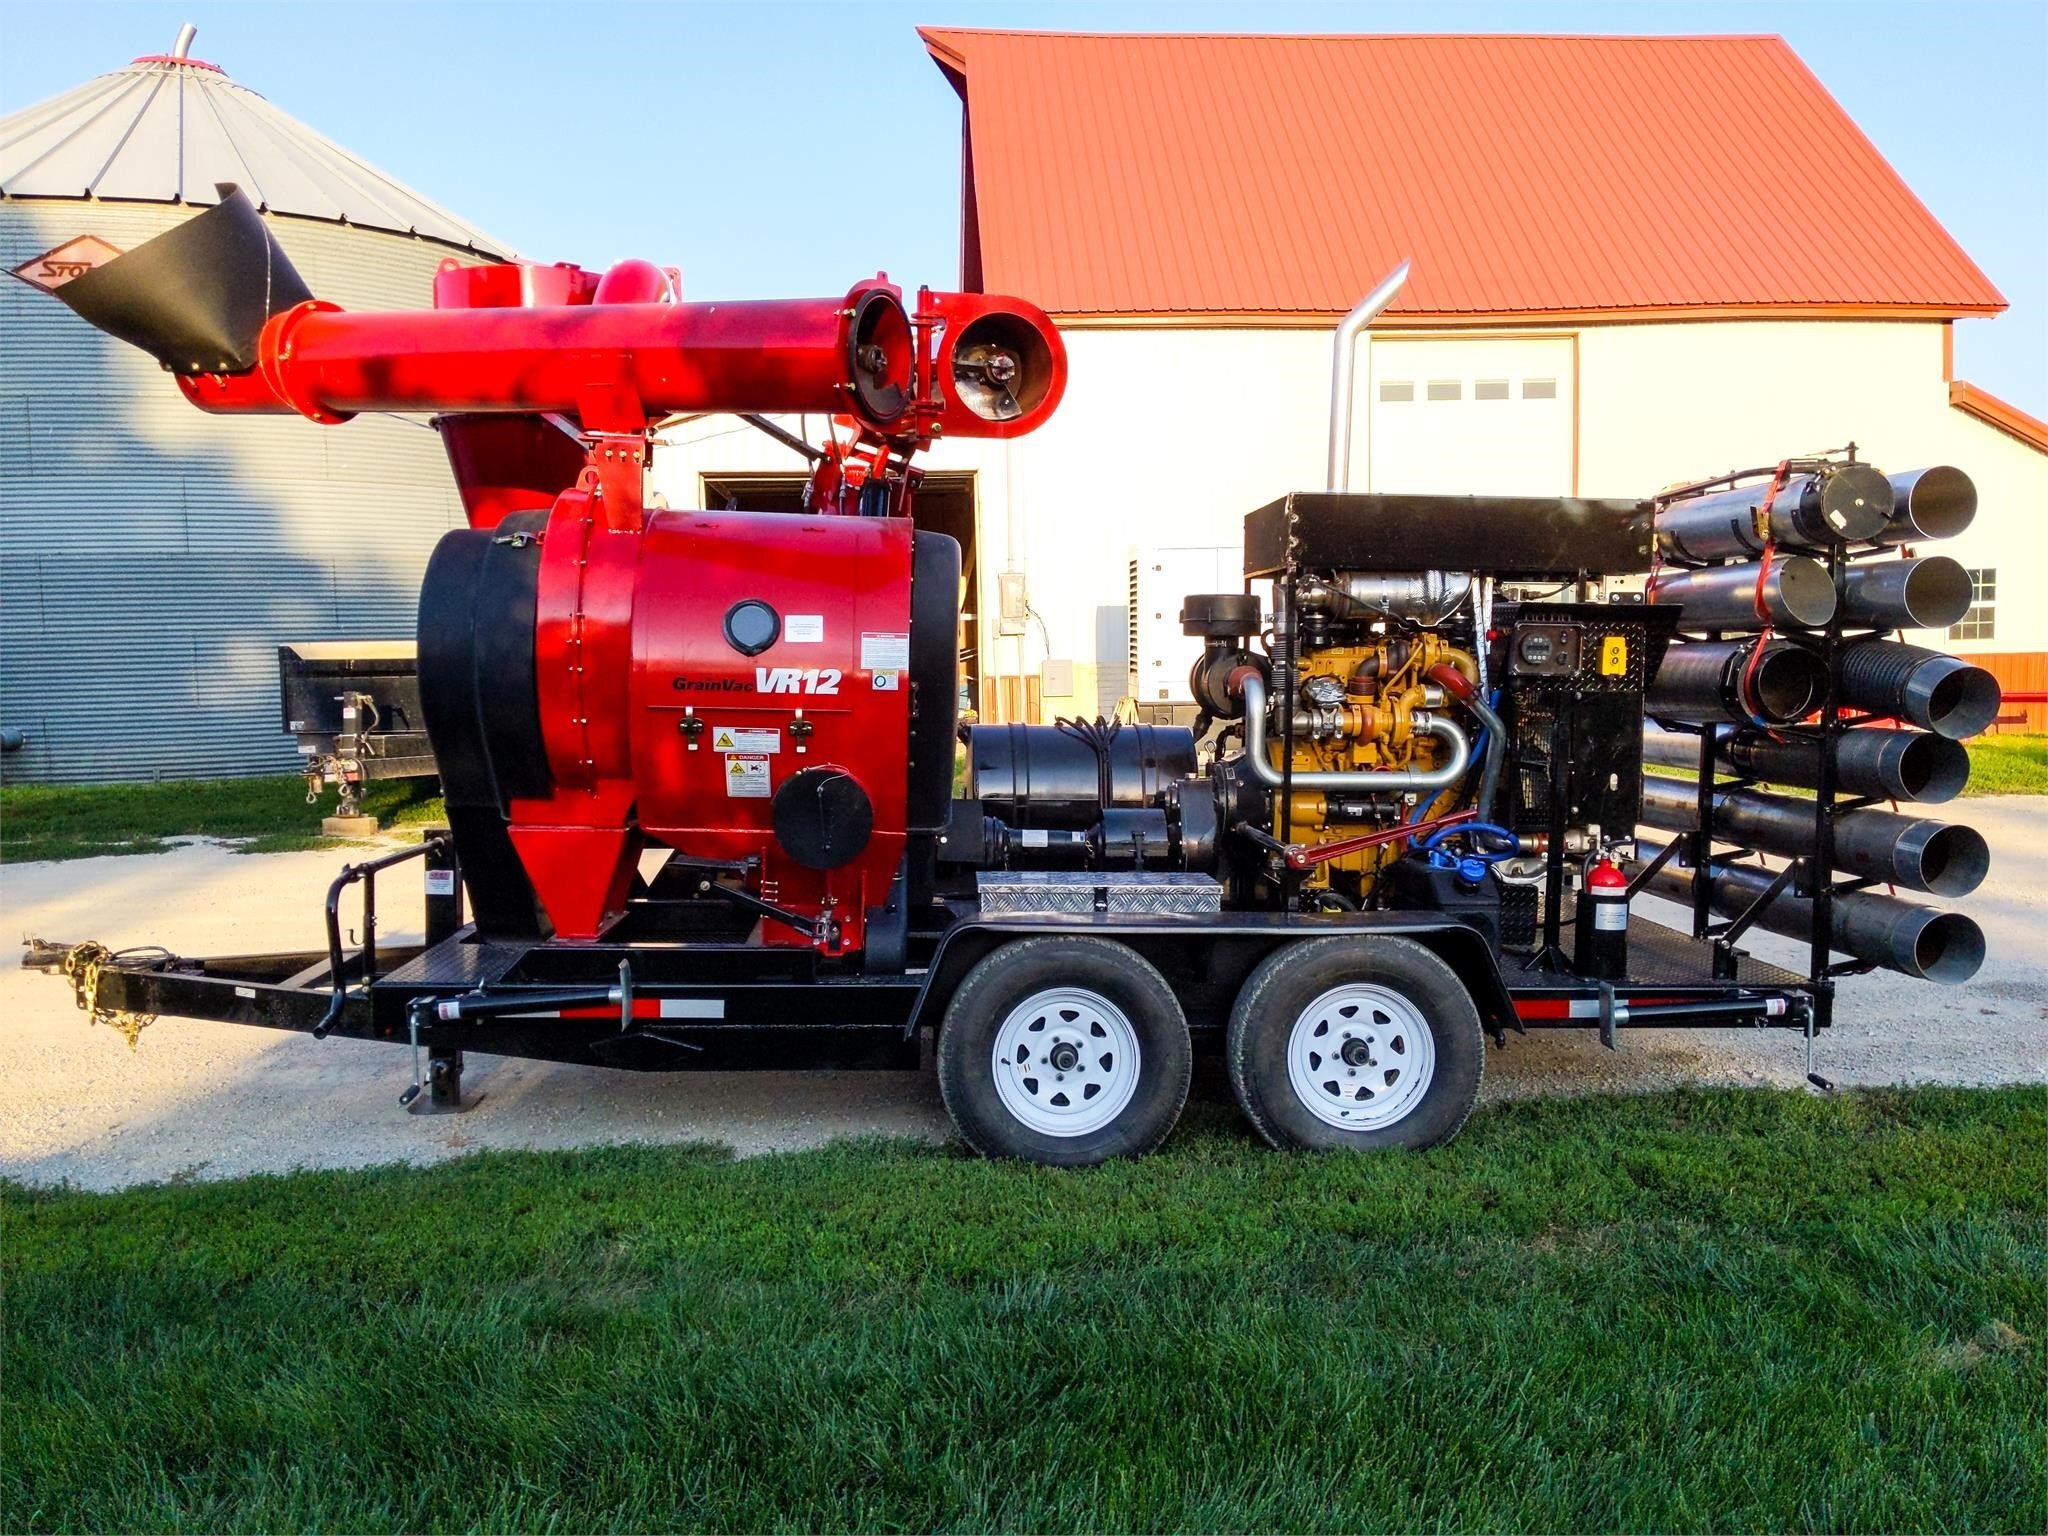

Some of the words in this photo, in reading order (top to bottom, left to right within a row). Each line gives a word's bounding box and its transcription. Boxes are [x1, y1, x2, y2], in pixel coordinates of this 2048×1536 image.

[38, 261, 95, 278] STO
[672, 677, 754, 692] GrainVac
[755, 667, 842, 695] VR12
